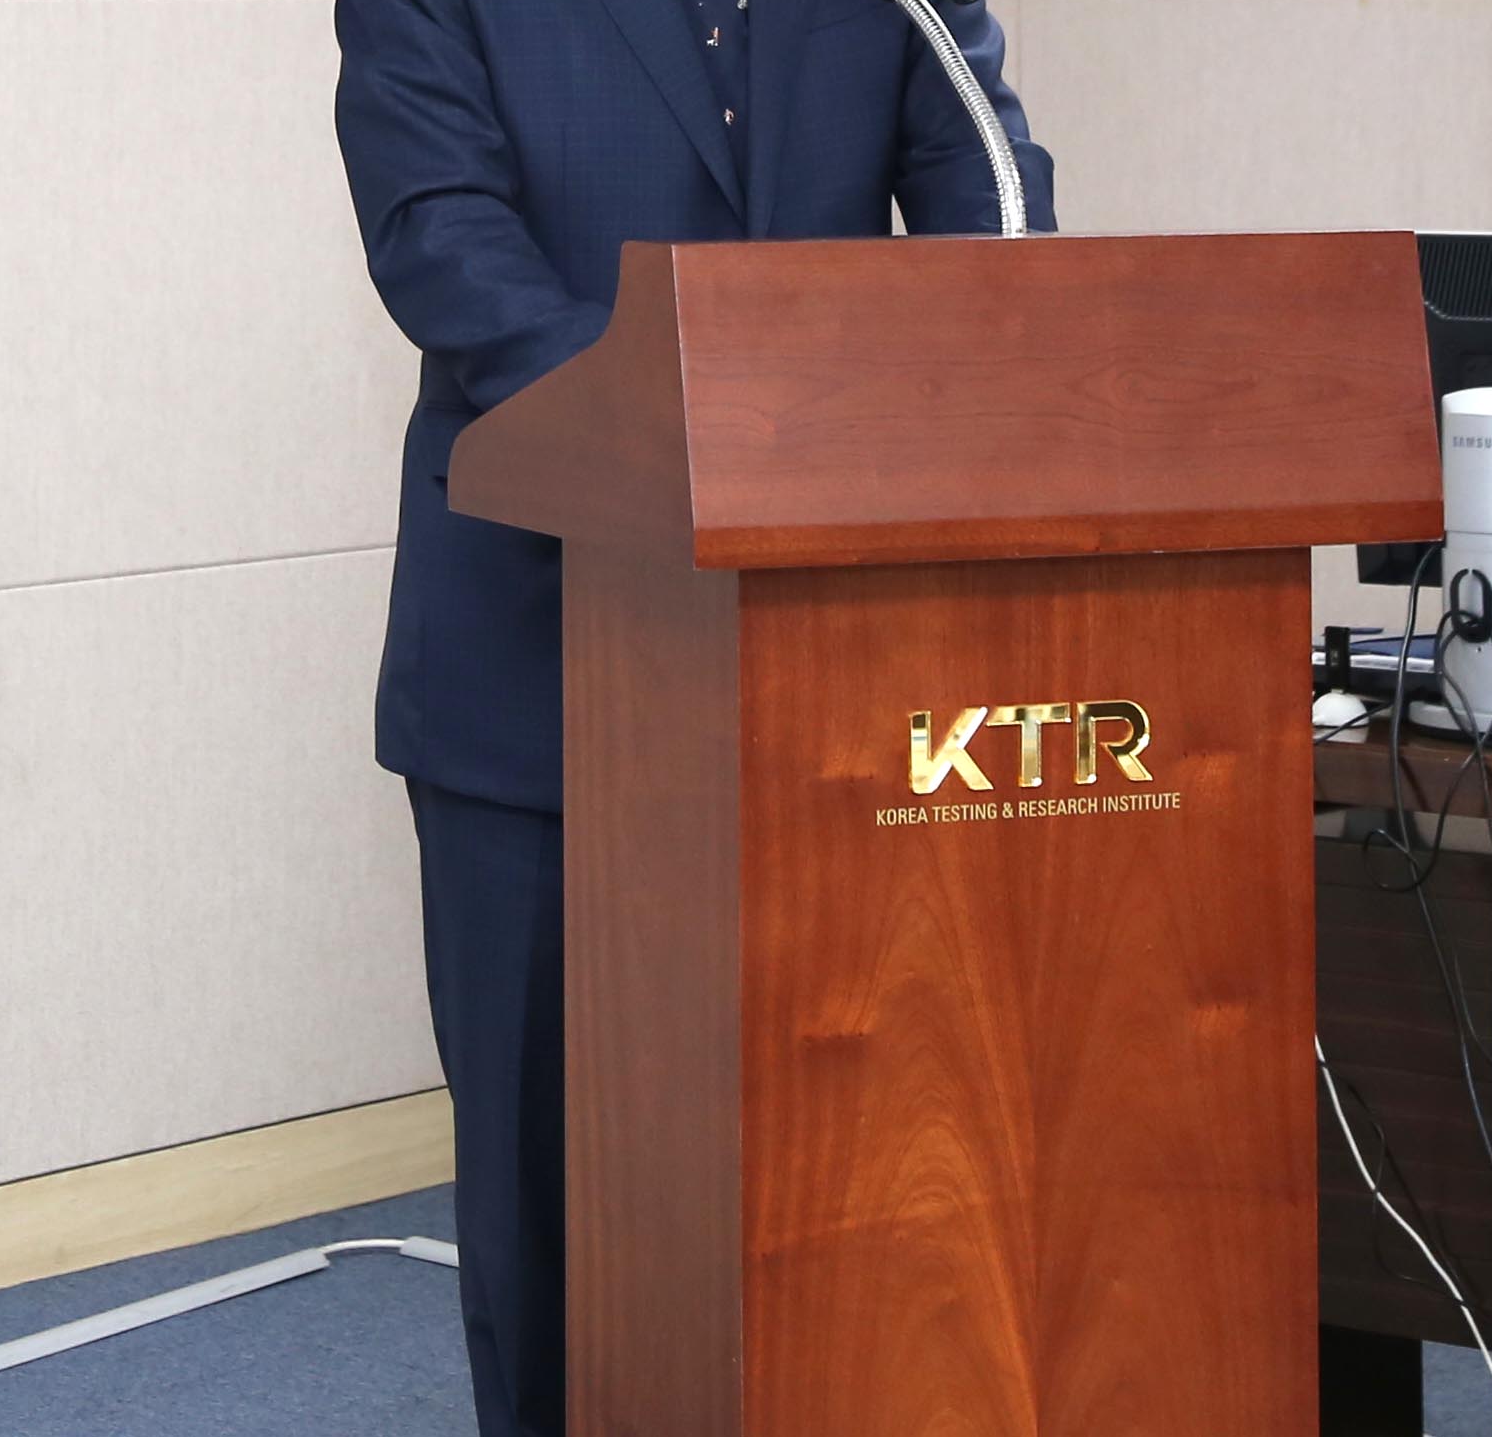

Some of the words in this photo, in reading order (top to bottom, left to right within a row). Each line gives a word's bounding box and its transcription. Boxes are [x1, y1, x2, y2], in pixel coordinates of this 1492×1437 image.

[908, 699, 1154, 795] KTR
[875, 806, 929, 827] KOREA
[931, 802, 998, 823] TESTING
[1001, 801, 1015, 819] &
[1018, 796, 1098, 819] RESEARCH
[1101, 791, 1182, 814] INSTITUTE
